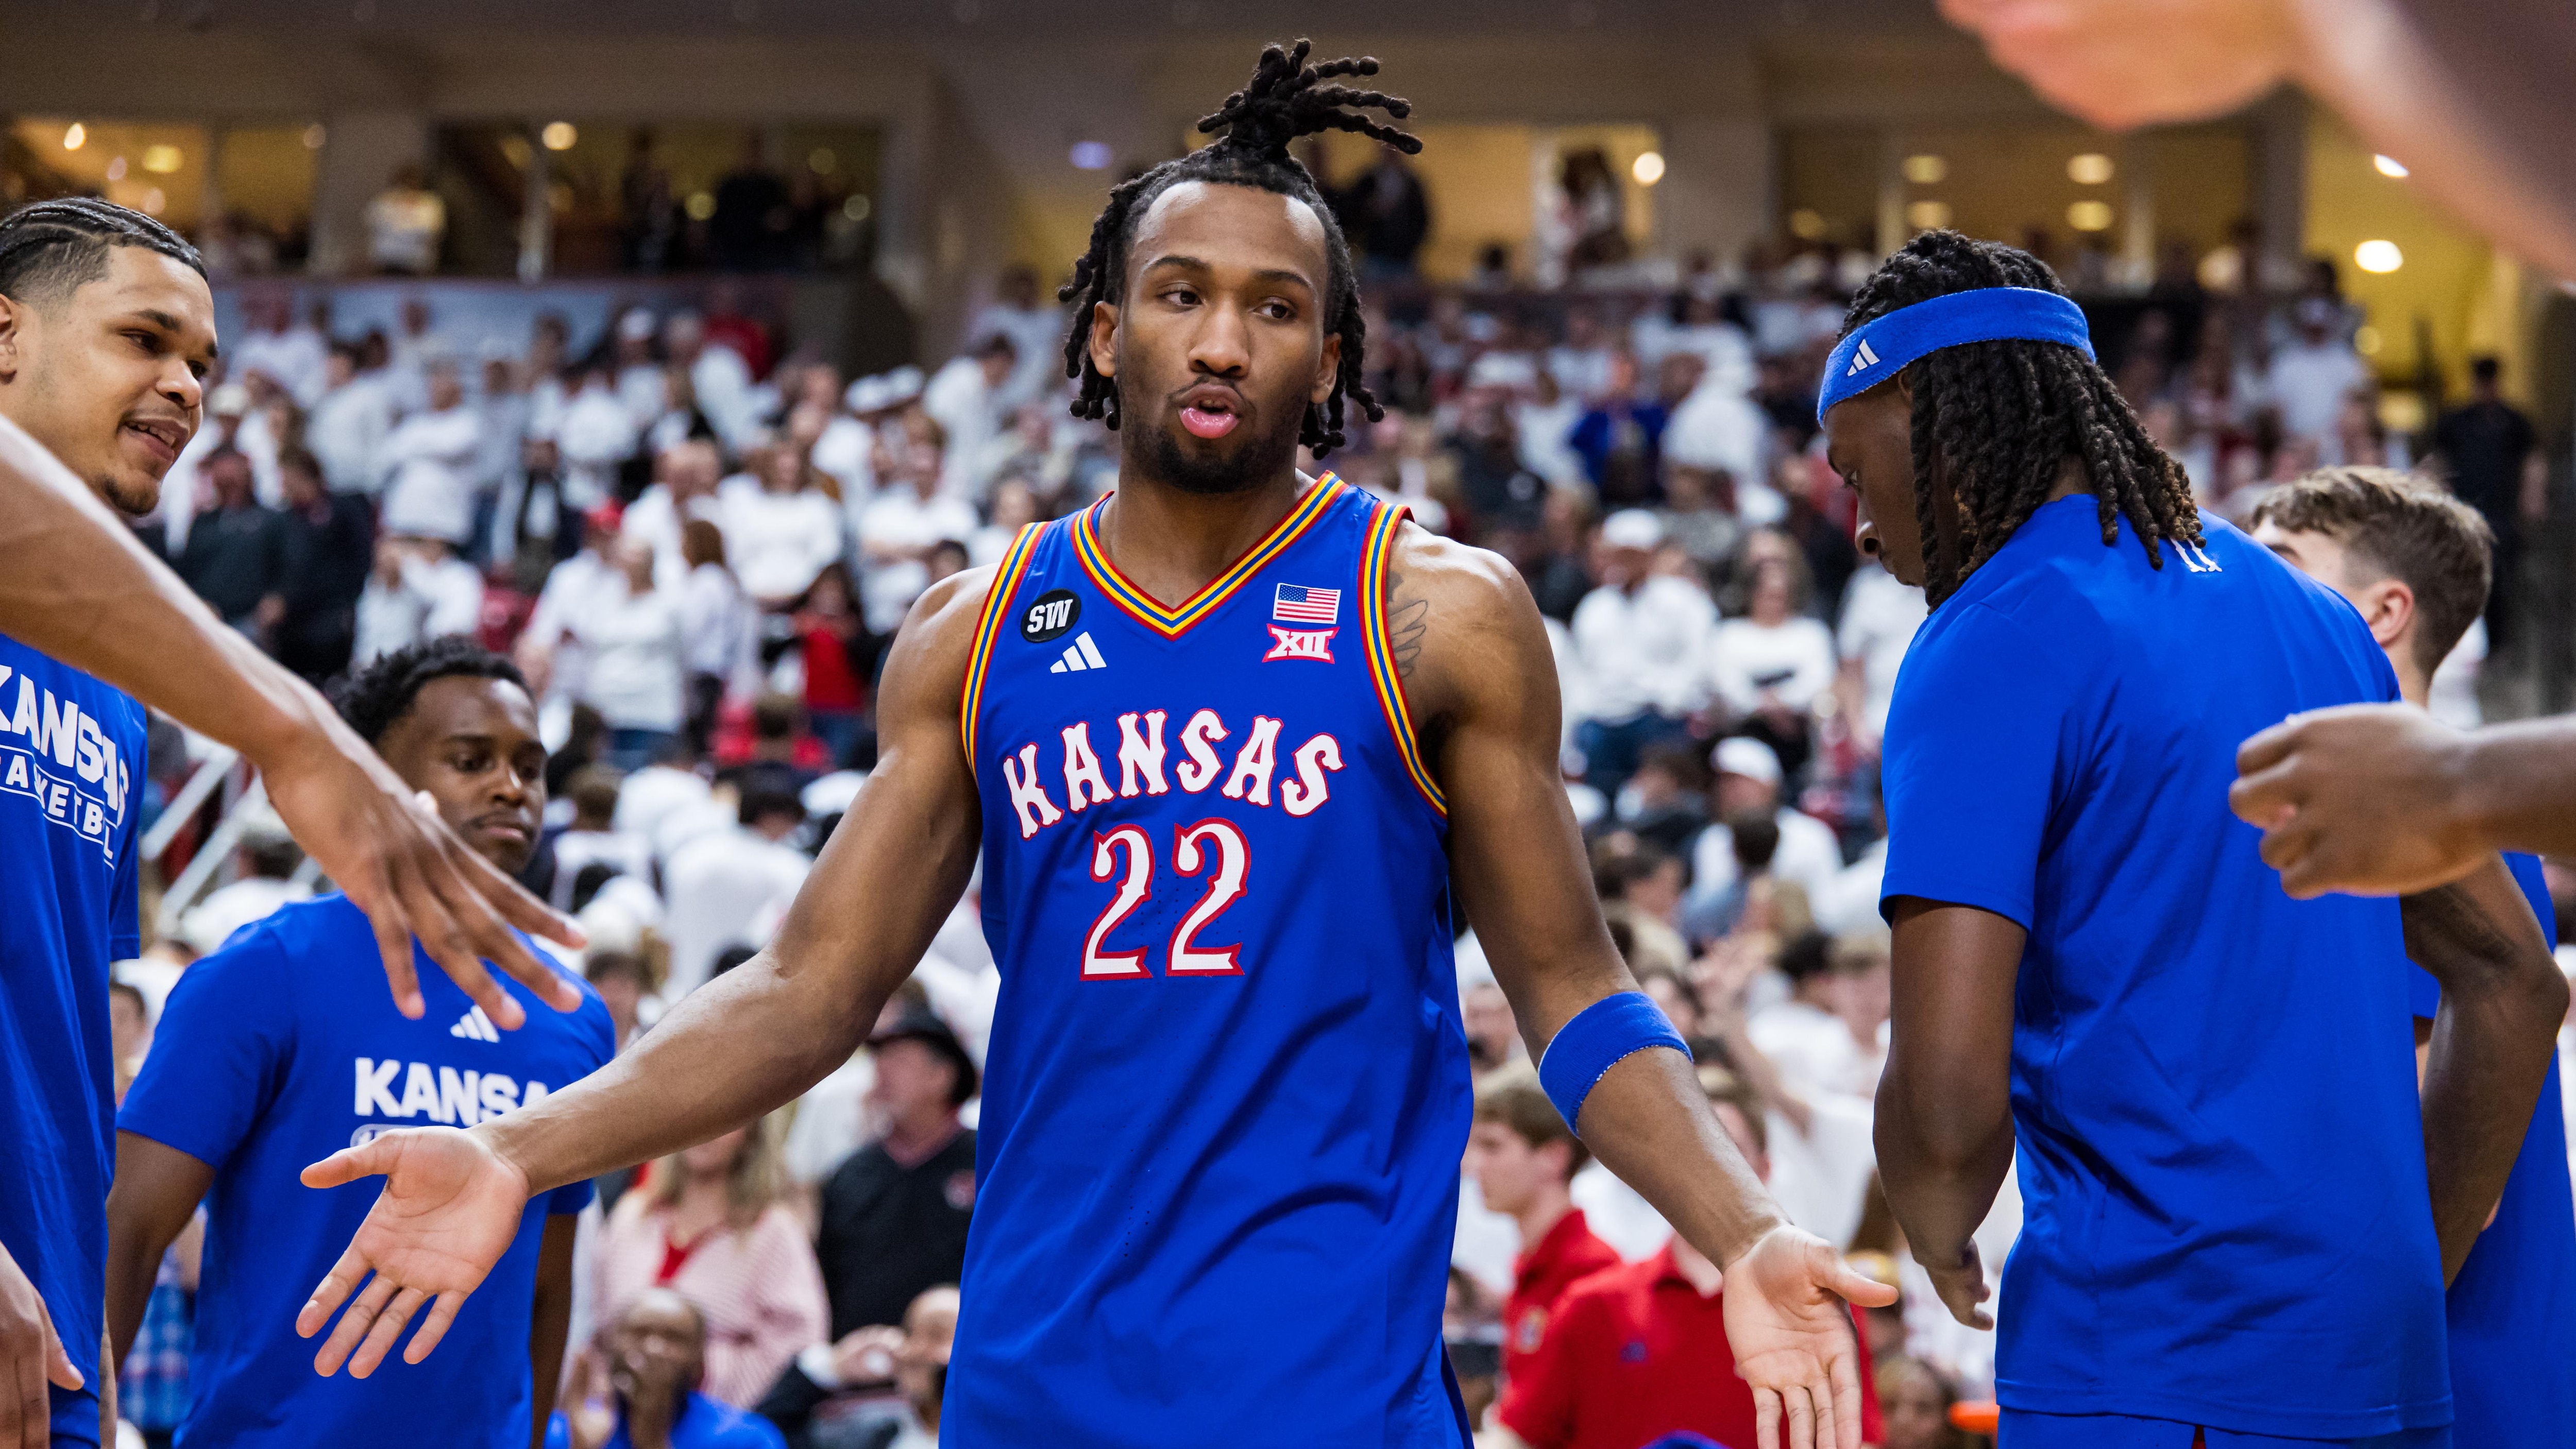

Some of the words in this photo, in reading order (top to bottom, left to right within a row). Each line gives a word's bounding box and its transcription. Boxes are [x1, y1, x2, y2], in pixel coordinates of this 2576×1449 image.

[1027, 599, 1073, 633] SW
[1265, 625, 1337, 662] XII
[1003, 708, 1347, 841] KANSAS
[1080, 817, 1251, 981] 22
